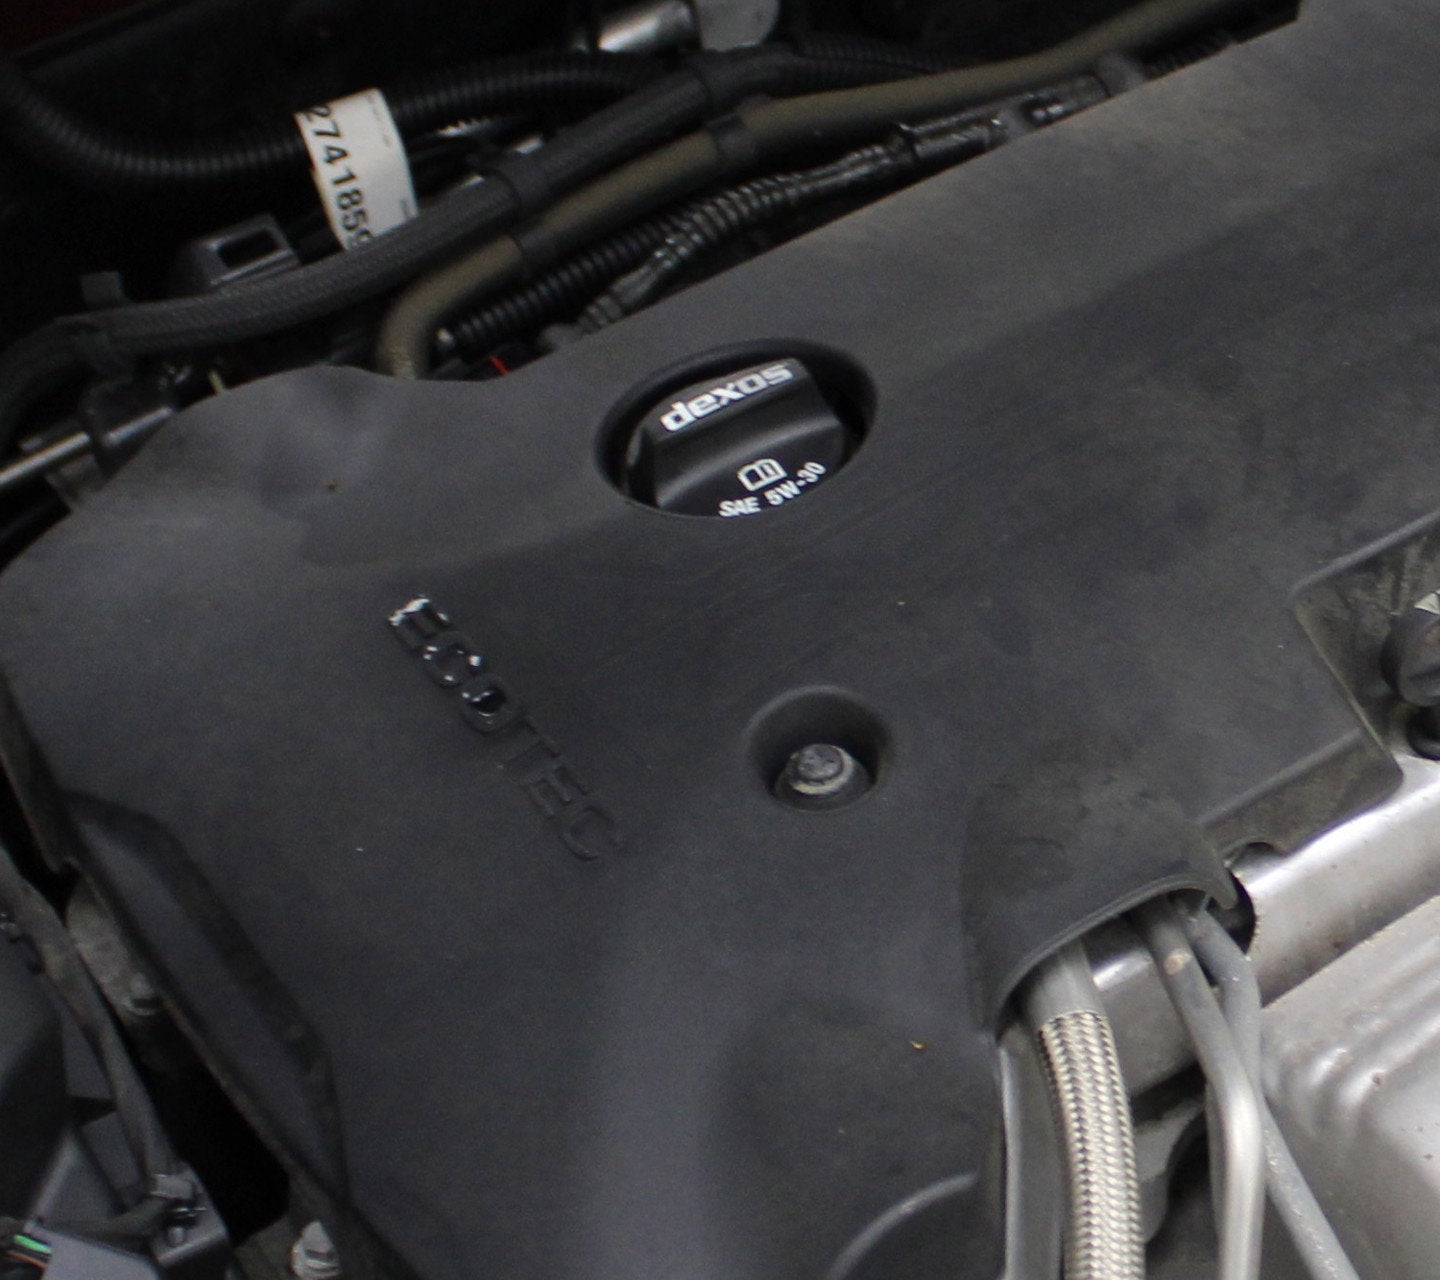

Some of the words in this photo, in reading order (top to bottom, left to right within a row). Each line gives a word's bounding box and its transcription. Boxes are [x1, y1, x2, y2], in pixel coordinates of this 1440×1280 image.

[660, 364, 793, 431] dexos
[719, 497, 762, 517] SAE
[764, 461, 827, 505] 5W-30
[389, 597, 615, 862] ECOTEC
